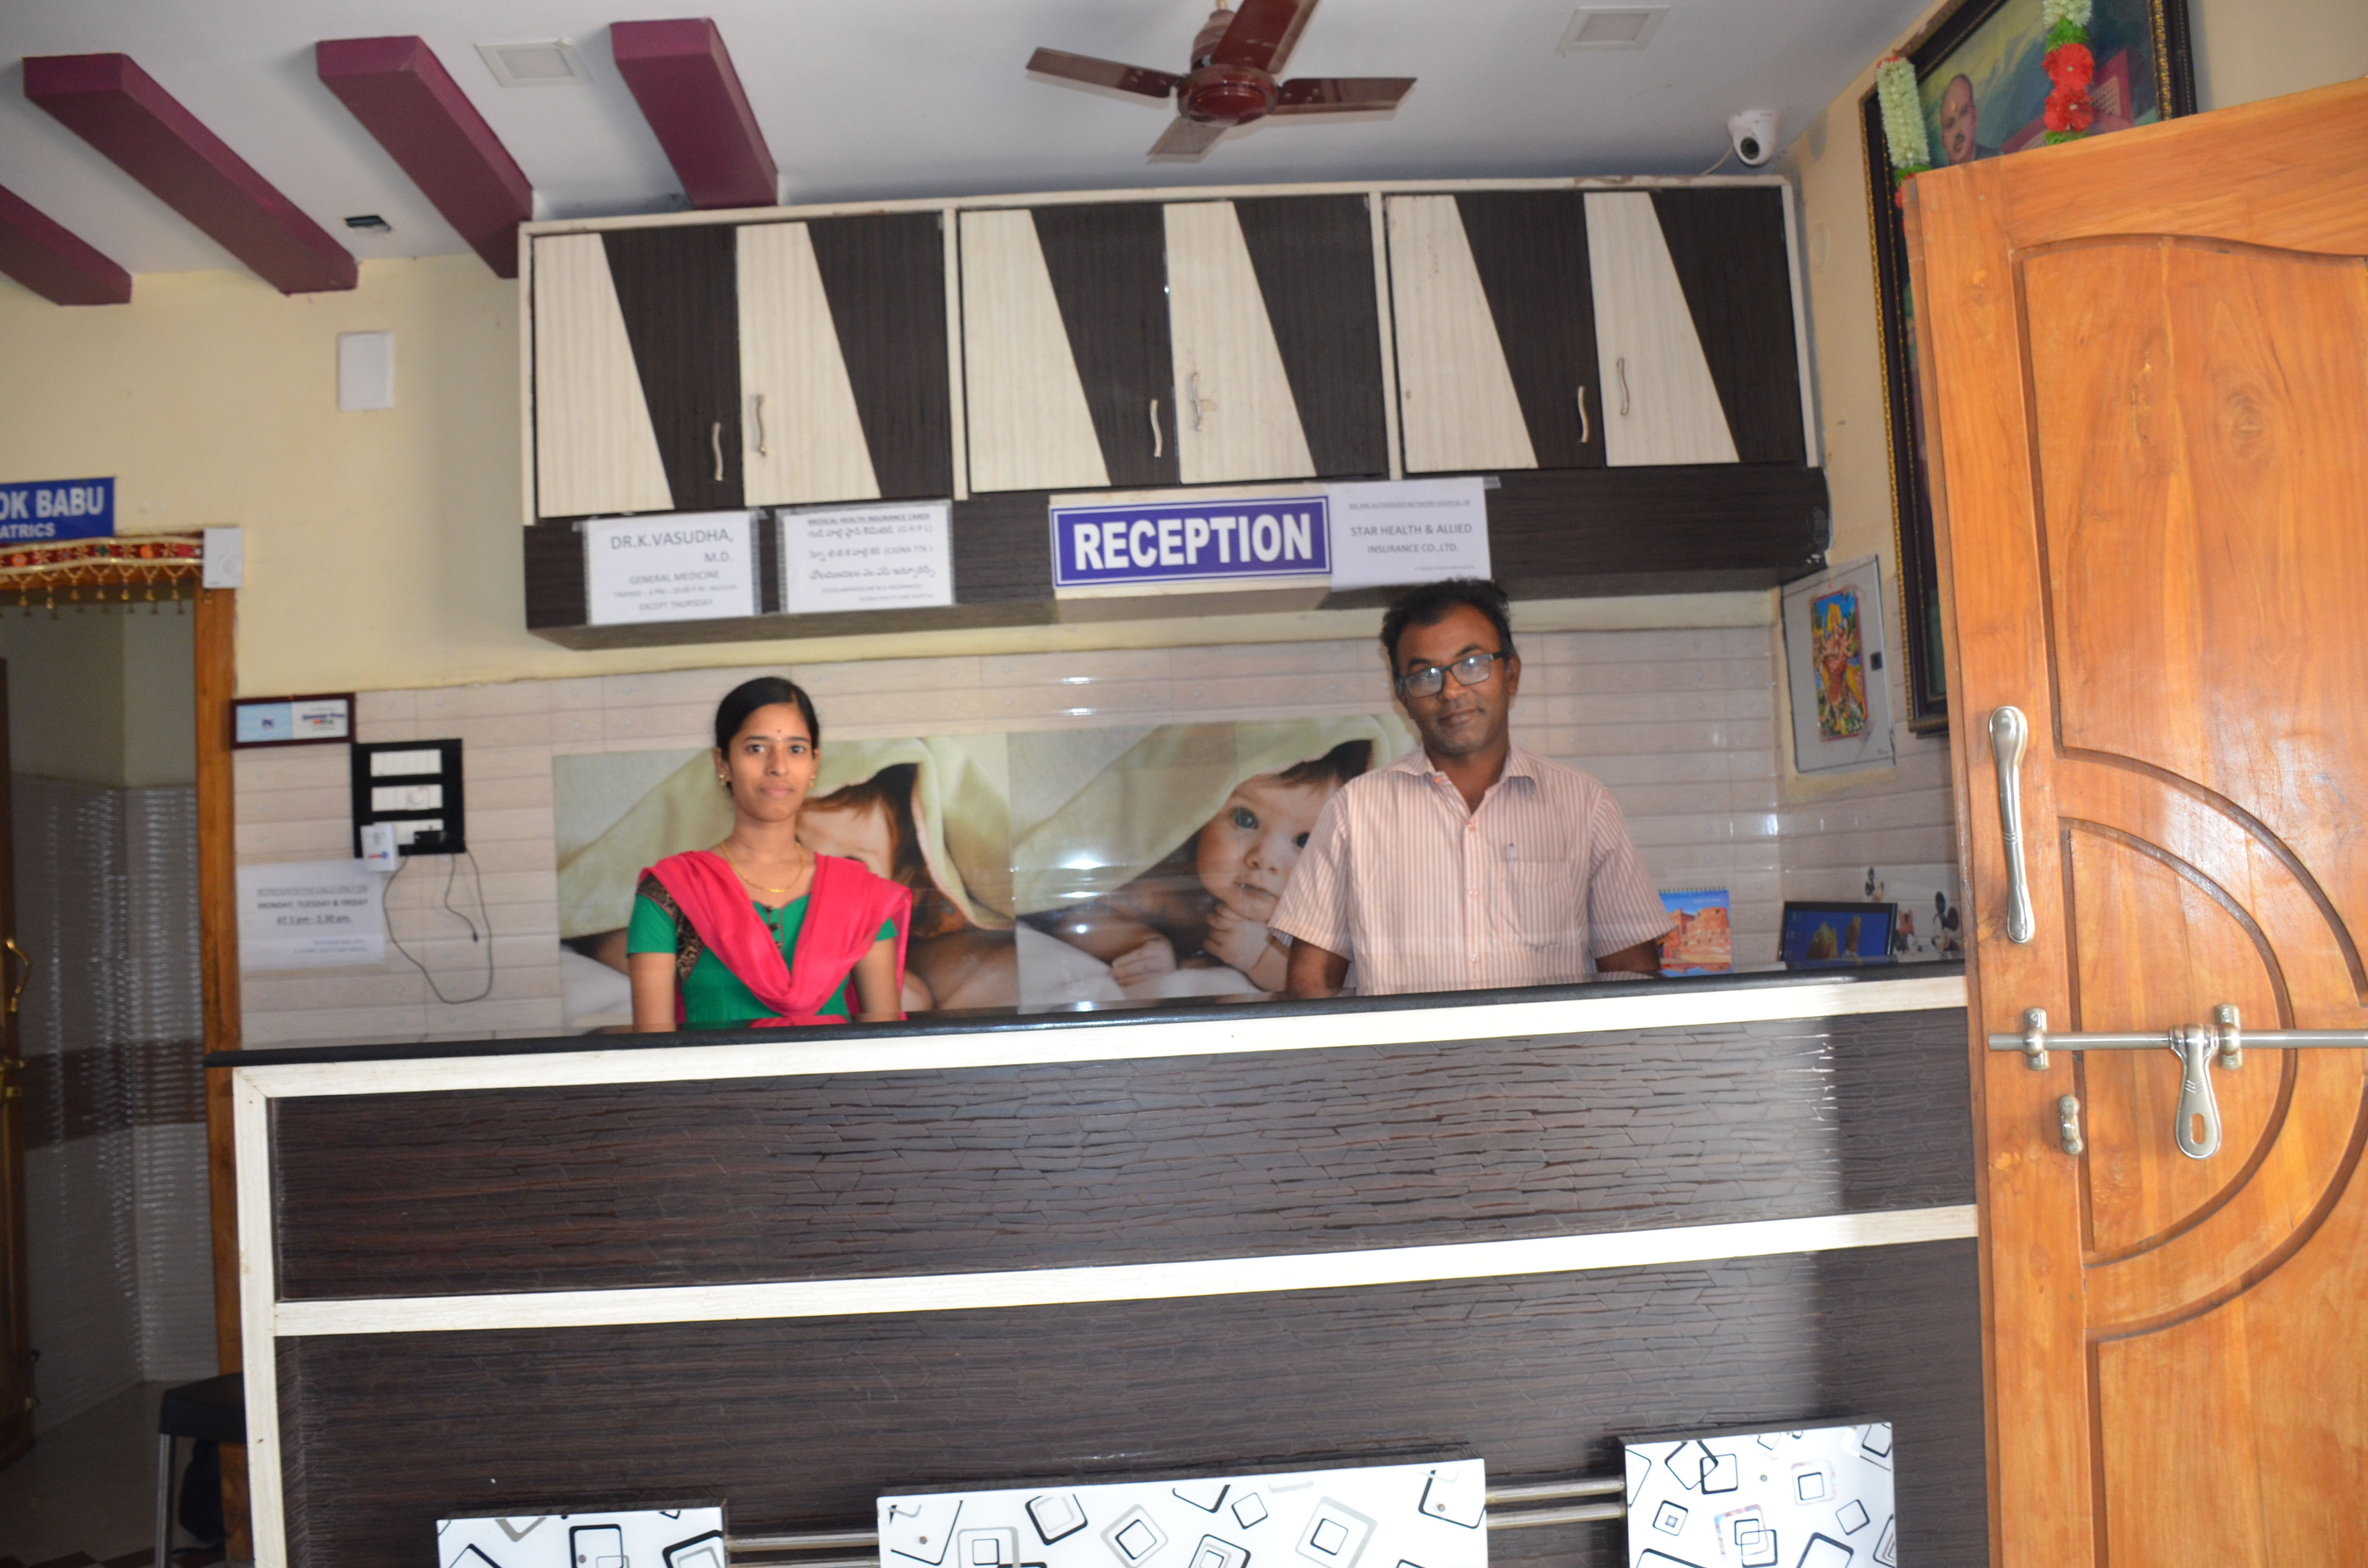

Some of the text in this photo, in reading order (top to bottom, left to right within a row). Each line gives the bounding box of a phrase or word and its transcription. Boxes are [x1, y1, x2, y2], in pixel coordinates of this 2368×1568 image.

[36, 486, 104, 518] BABU
[807, 512, 931, 527] MEDICAL HEALTH INSURANCE CARDS
[1350, 523, 1472, 537] STAR HEALTH & ALLIED
[610, 528, 734, 550] DR.K.VASUDHA,
[1073, 513, 1312, 571] RECEPTION
[1367, 543, 1420, 553] INSURANCE
[704, 551, 732, 564] M.D.
[628, 570, 719, 585] GENERAL MEDICINE
[639, 599, 713, 611] EXCEPT THURSDAY
[296, 900, 331, 908] TUESDAY
